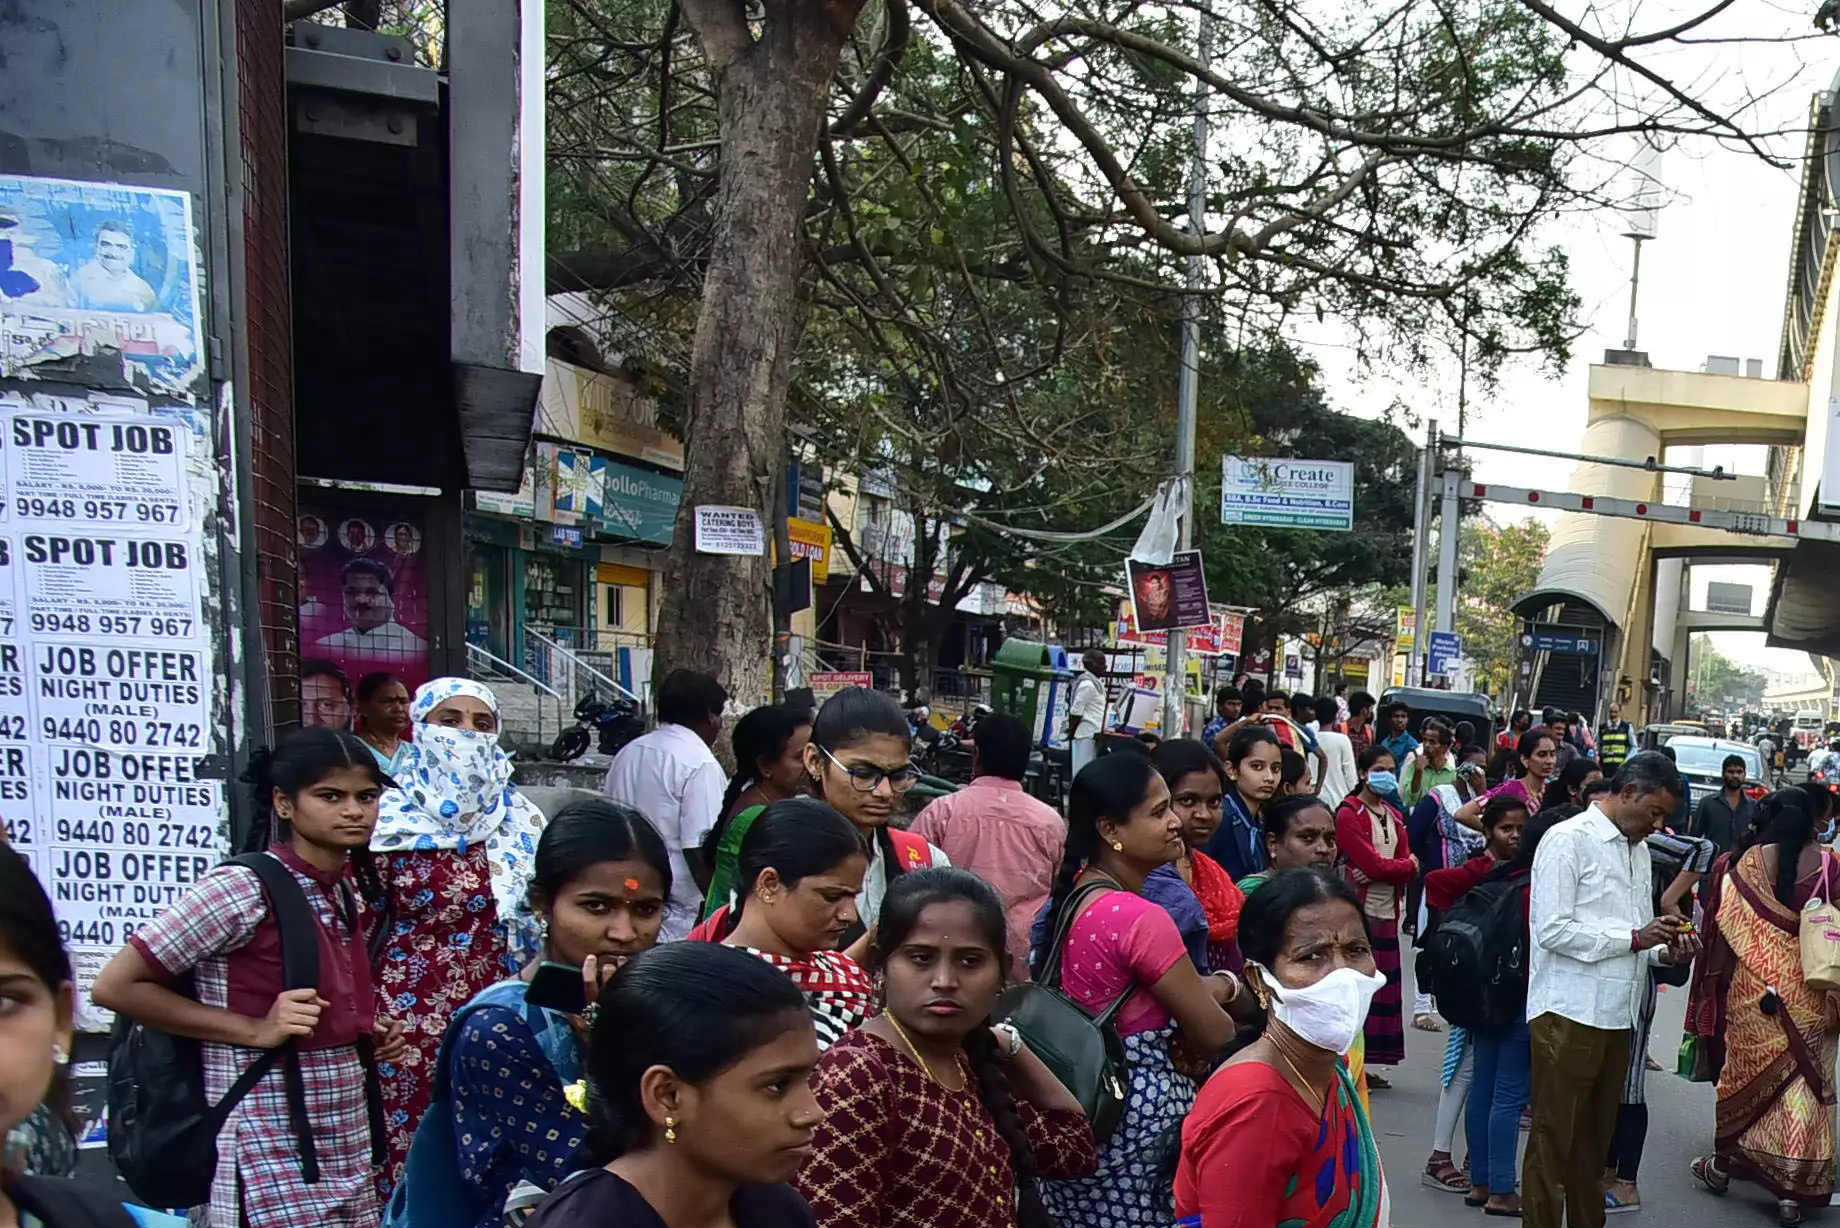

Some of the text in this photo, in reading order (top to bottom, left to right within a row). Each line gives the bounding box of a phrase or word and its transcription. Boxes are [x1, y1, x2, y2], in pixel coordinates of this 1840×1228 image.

[13, 417, 101, 450] SPOT
[110, 424, 173, 455] JOB
[1274, 463, 1334, 482] Create
[1295, 481, 1328, 489] COLLEGE
[16, 498, 76, 518] 9948
[84, 501, 128, 520] 957
[136, 503, 179, 523] 967
[1263, 496, 1281, 504] Food
[701, 511, 754, 519] WANTED
[702, 519, 756, 528] CATERING BOYS
[566, 529, 580, 542] TEST
[24, 535, 116, 566] SPOT
[125, 541, 188, 570] JOB
[31, 613, 193, 637] 9948 957 967
[40, 646, 96, 676] JOB
[107, 649, 197, 682] OFFER
[40, 678, 111, 701] NIGHT
[119, 682, 199, 705] DUTIES
[84, 702, 159, 720] (MALE)
[43, 716, 200, 747] 9440 80 2742
[55, 748, 111, 779] JOB
[56, 780, 126, 803] NIGHT
[133, 784, 212, 807] DUTIES
[99, 805, 172, 822] (MALE)
[57, 818, 212, 849] 9440 80 2742
[56, 850, 208, 884] JOB OFFER
[56, 882, 125, 904] NIGHT
[59, 920, 115, 945] 9440
